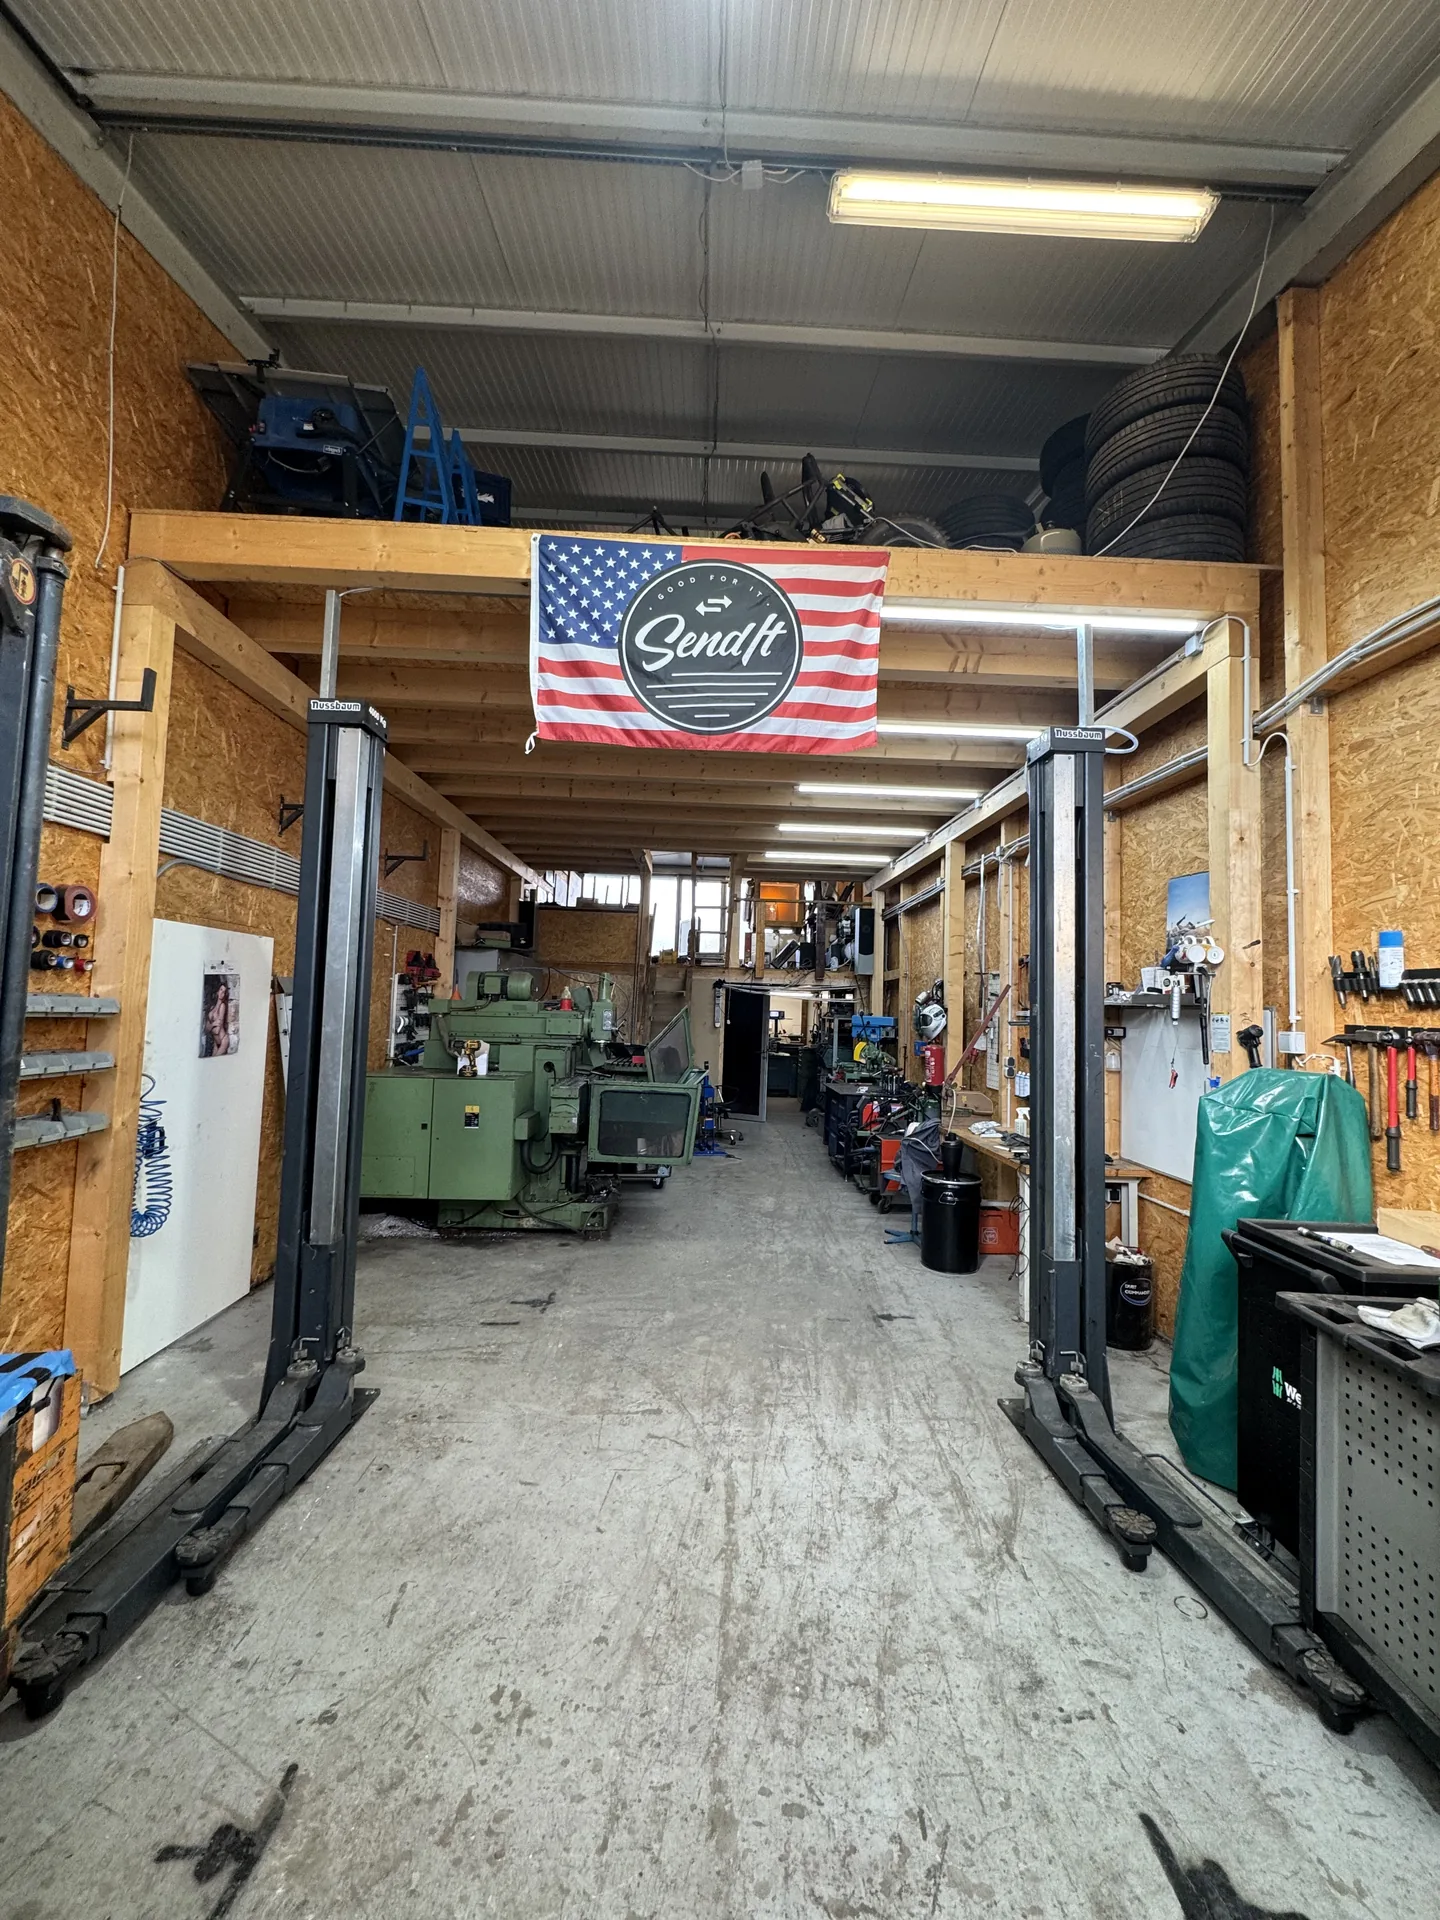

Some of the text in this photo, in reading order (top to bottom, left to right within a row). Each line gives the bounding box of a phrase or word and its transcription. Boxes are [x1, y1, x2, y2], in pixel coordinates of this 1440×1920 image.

[657, 574, 762, 600] GOOD FOR IT
